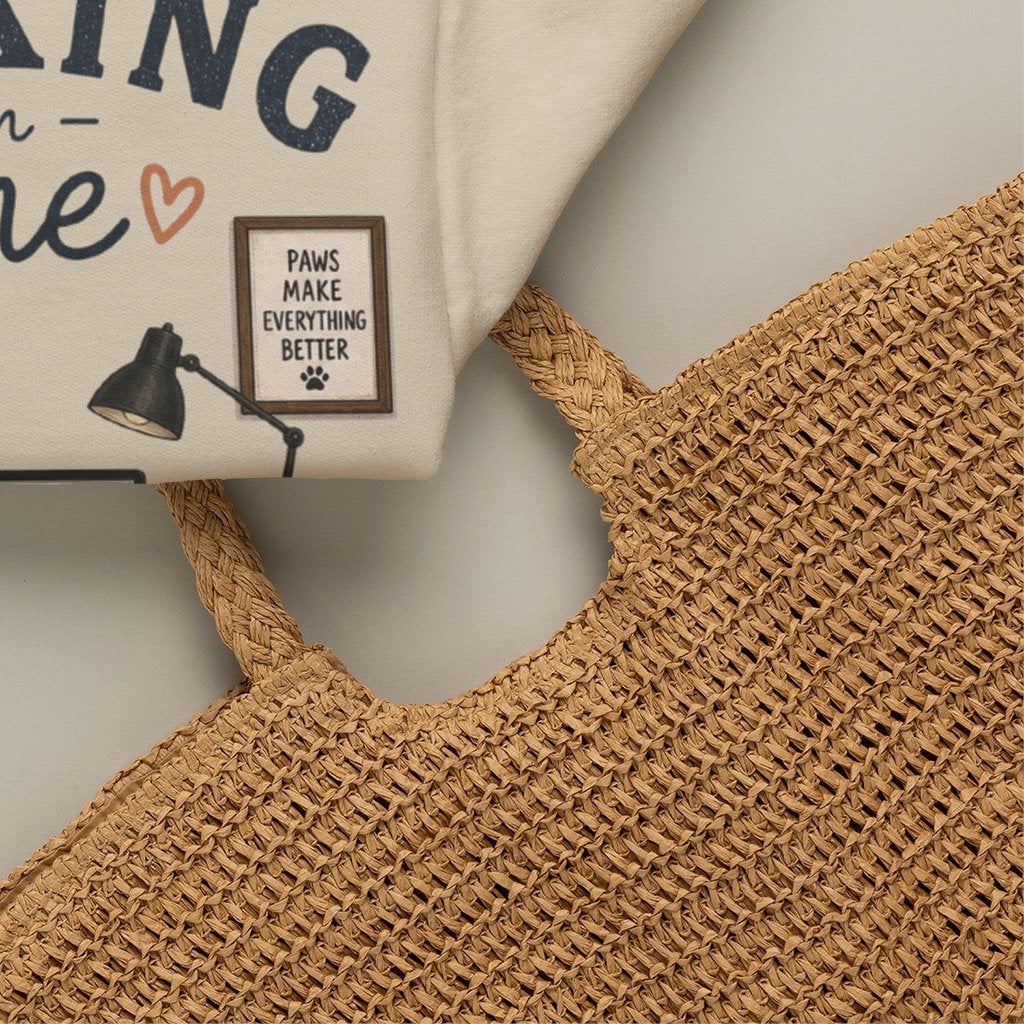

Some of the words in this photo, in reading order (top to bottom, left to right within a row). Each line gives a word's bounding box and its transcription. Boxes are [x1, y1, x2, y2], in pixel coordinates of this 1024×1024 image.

[287, 248, 340, 273] PAWS
[282, 278, 343, 302] MAKE
[263, 309, 367, 332] EVERYTHING
[281, 337, 349, 362] BETTER
